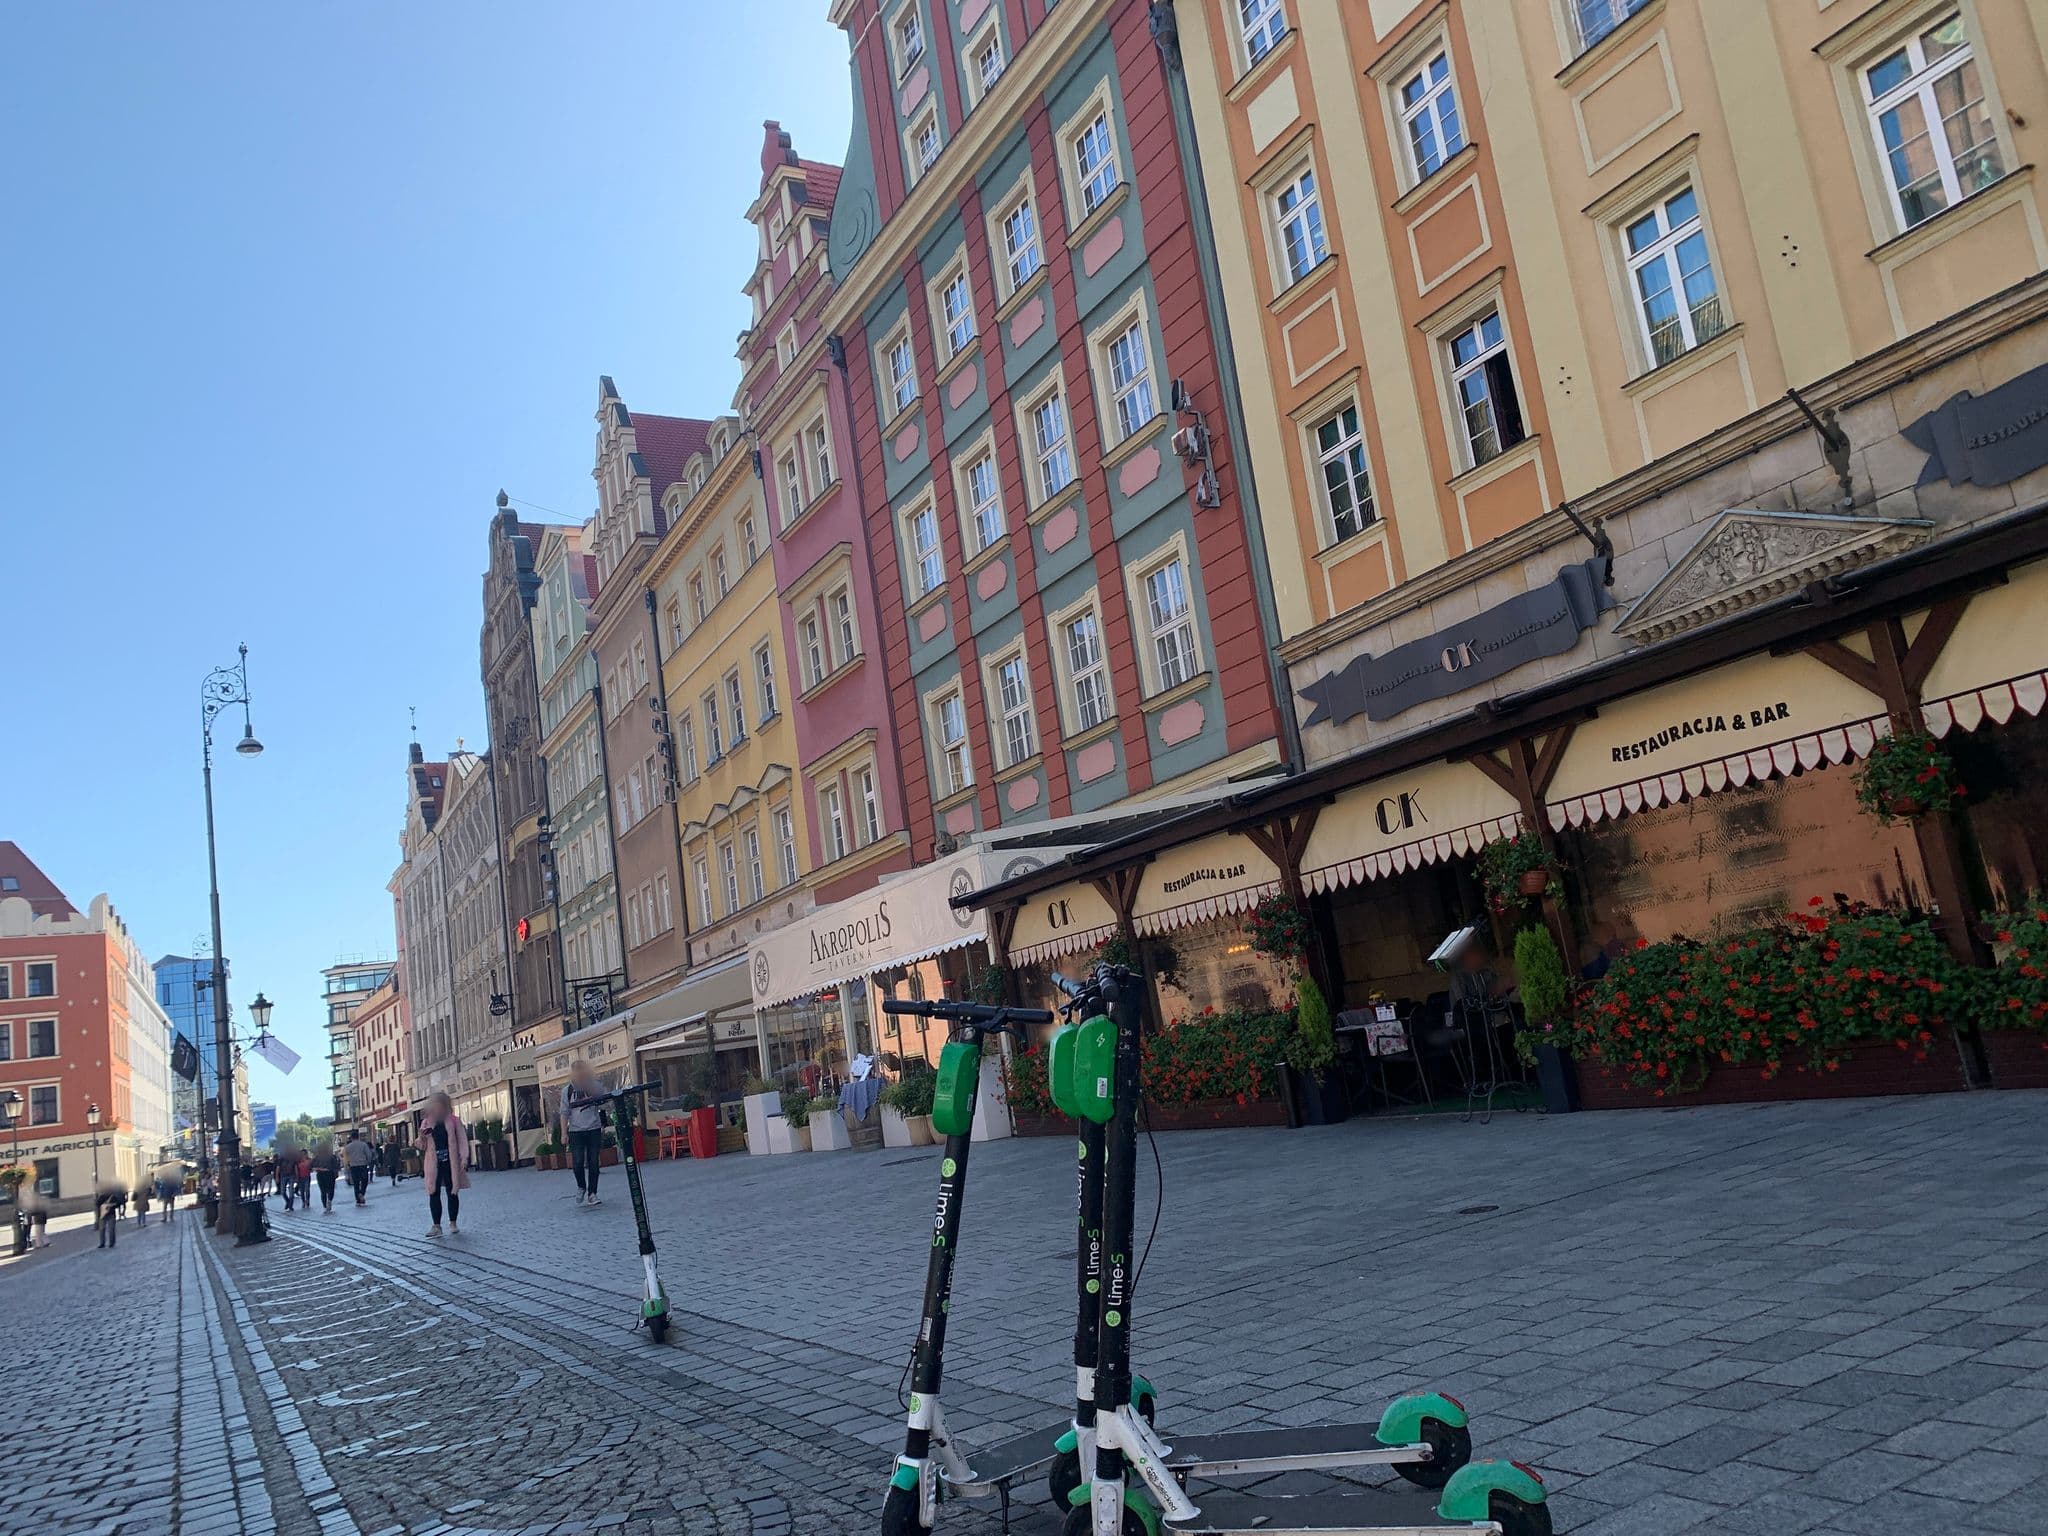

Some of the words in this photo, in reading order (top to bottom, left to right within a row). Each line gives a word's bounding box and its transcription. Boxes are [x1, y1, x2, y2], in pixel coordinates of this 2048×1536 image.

[1441, 639, 1480, 673] CK
[1612, 716, 1726, 762] RESTAURACJA
[1732, 714, 1746, 731] &
[1750, 702, 1790, 728] BAR
[1375, 788, 1428, 834] CK
[1163, 868, 1217, 893] RESTAURACJA
[1219, 868, 1226, 880] &
[1226, 864, 1246, 879] BAR
[1047, 898, 1076, 929] CK
[828, 949, 872, 972] TAVERNA
[42, 1137, 112, 1154] AGRICOLE
